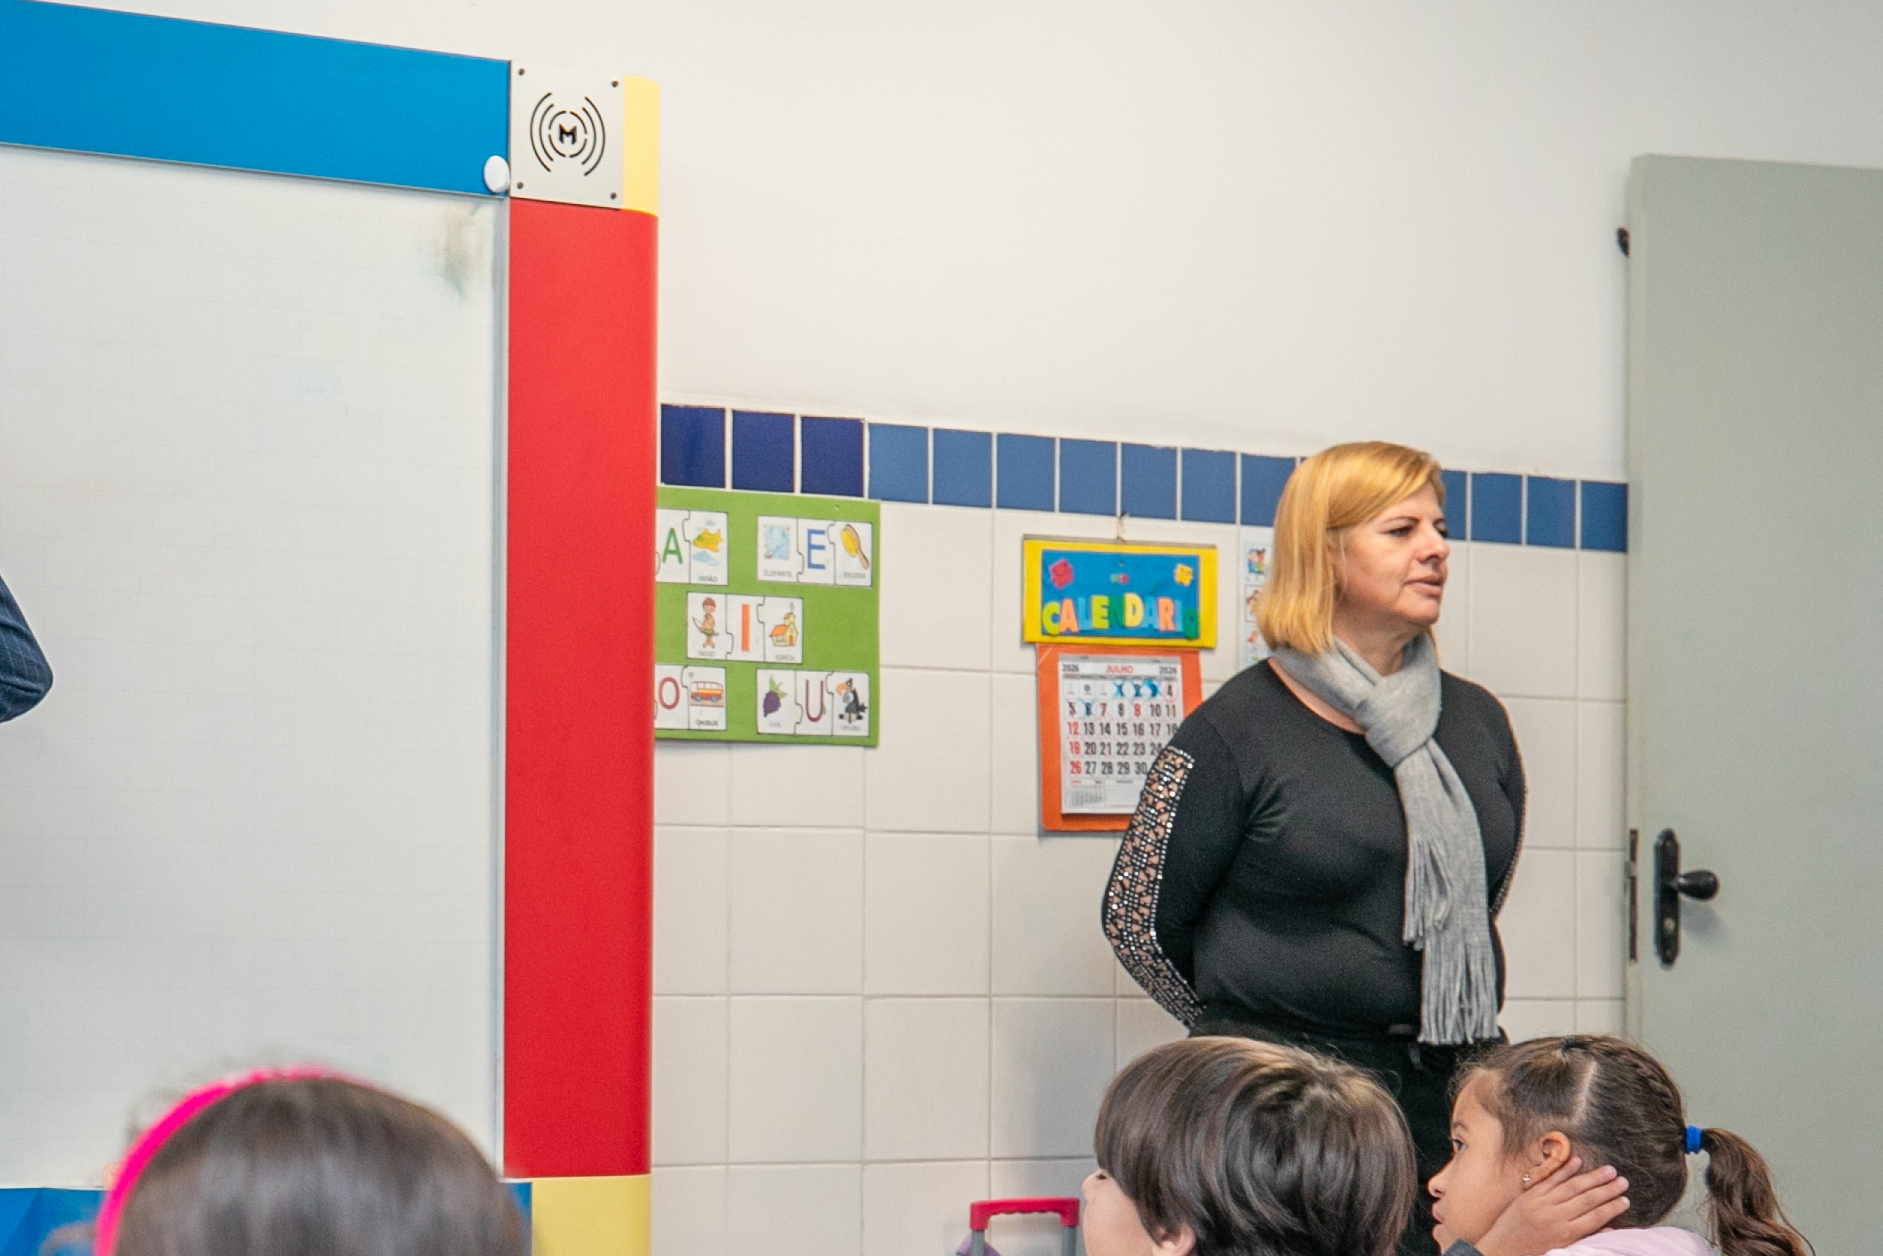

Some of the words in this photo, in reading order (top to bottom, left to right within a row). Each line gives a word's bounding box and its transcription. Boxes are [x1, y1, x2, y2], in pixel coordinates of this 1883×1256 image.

[662, 528, 683, 565] A
[806, 529, 827, 570] E
[741, 603, 750, 652] I
[805, 679, 825, 722] U
[1150, 704, 1162, 718] 10
[1165, 704, 1177, 718] 11
[1067, 721, 1079, 736] 12
[1083, 722, 1095, 736] 13
[1099, 722, 1112, 736] 14
[1116, 722, 1128, 736] 15
[1132, 722, 1145, 736] 16
[1150, 722, 1161, 736] 17
[1069, 741, 1081, 755] 19
[1084, 741, 1097, 755] 20
[1099, 741, 1112, 756] 21
[1116, 741, 1129, 756] 22
[1133, 741, 1146, 756] 23
[1069, 761, 1082, 775] 26
[1084, 761, 1097, 775] 27
[1101, 761, 1113, 775] 28
[1117, 761, 1130, 775] 29
[1134, 761, 1148, 775] 30
